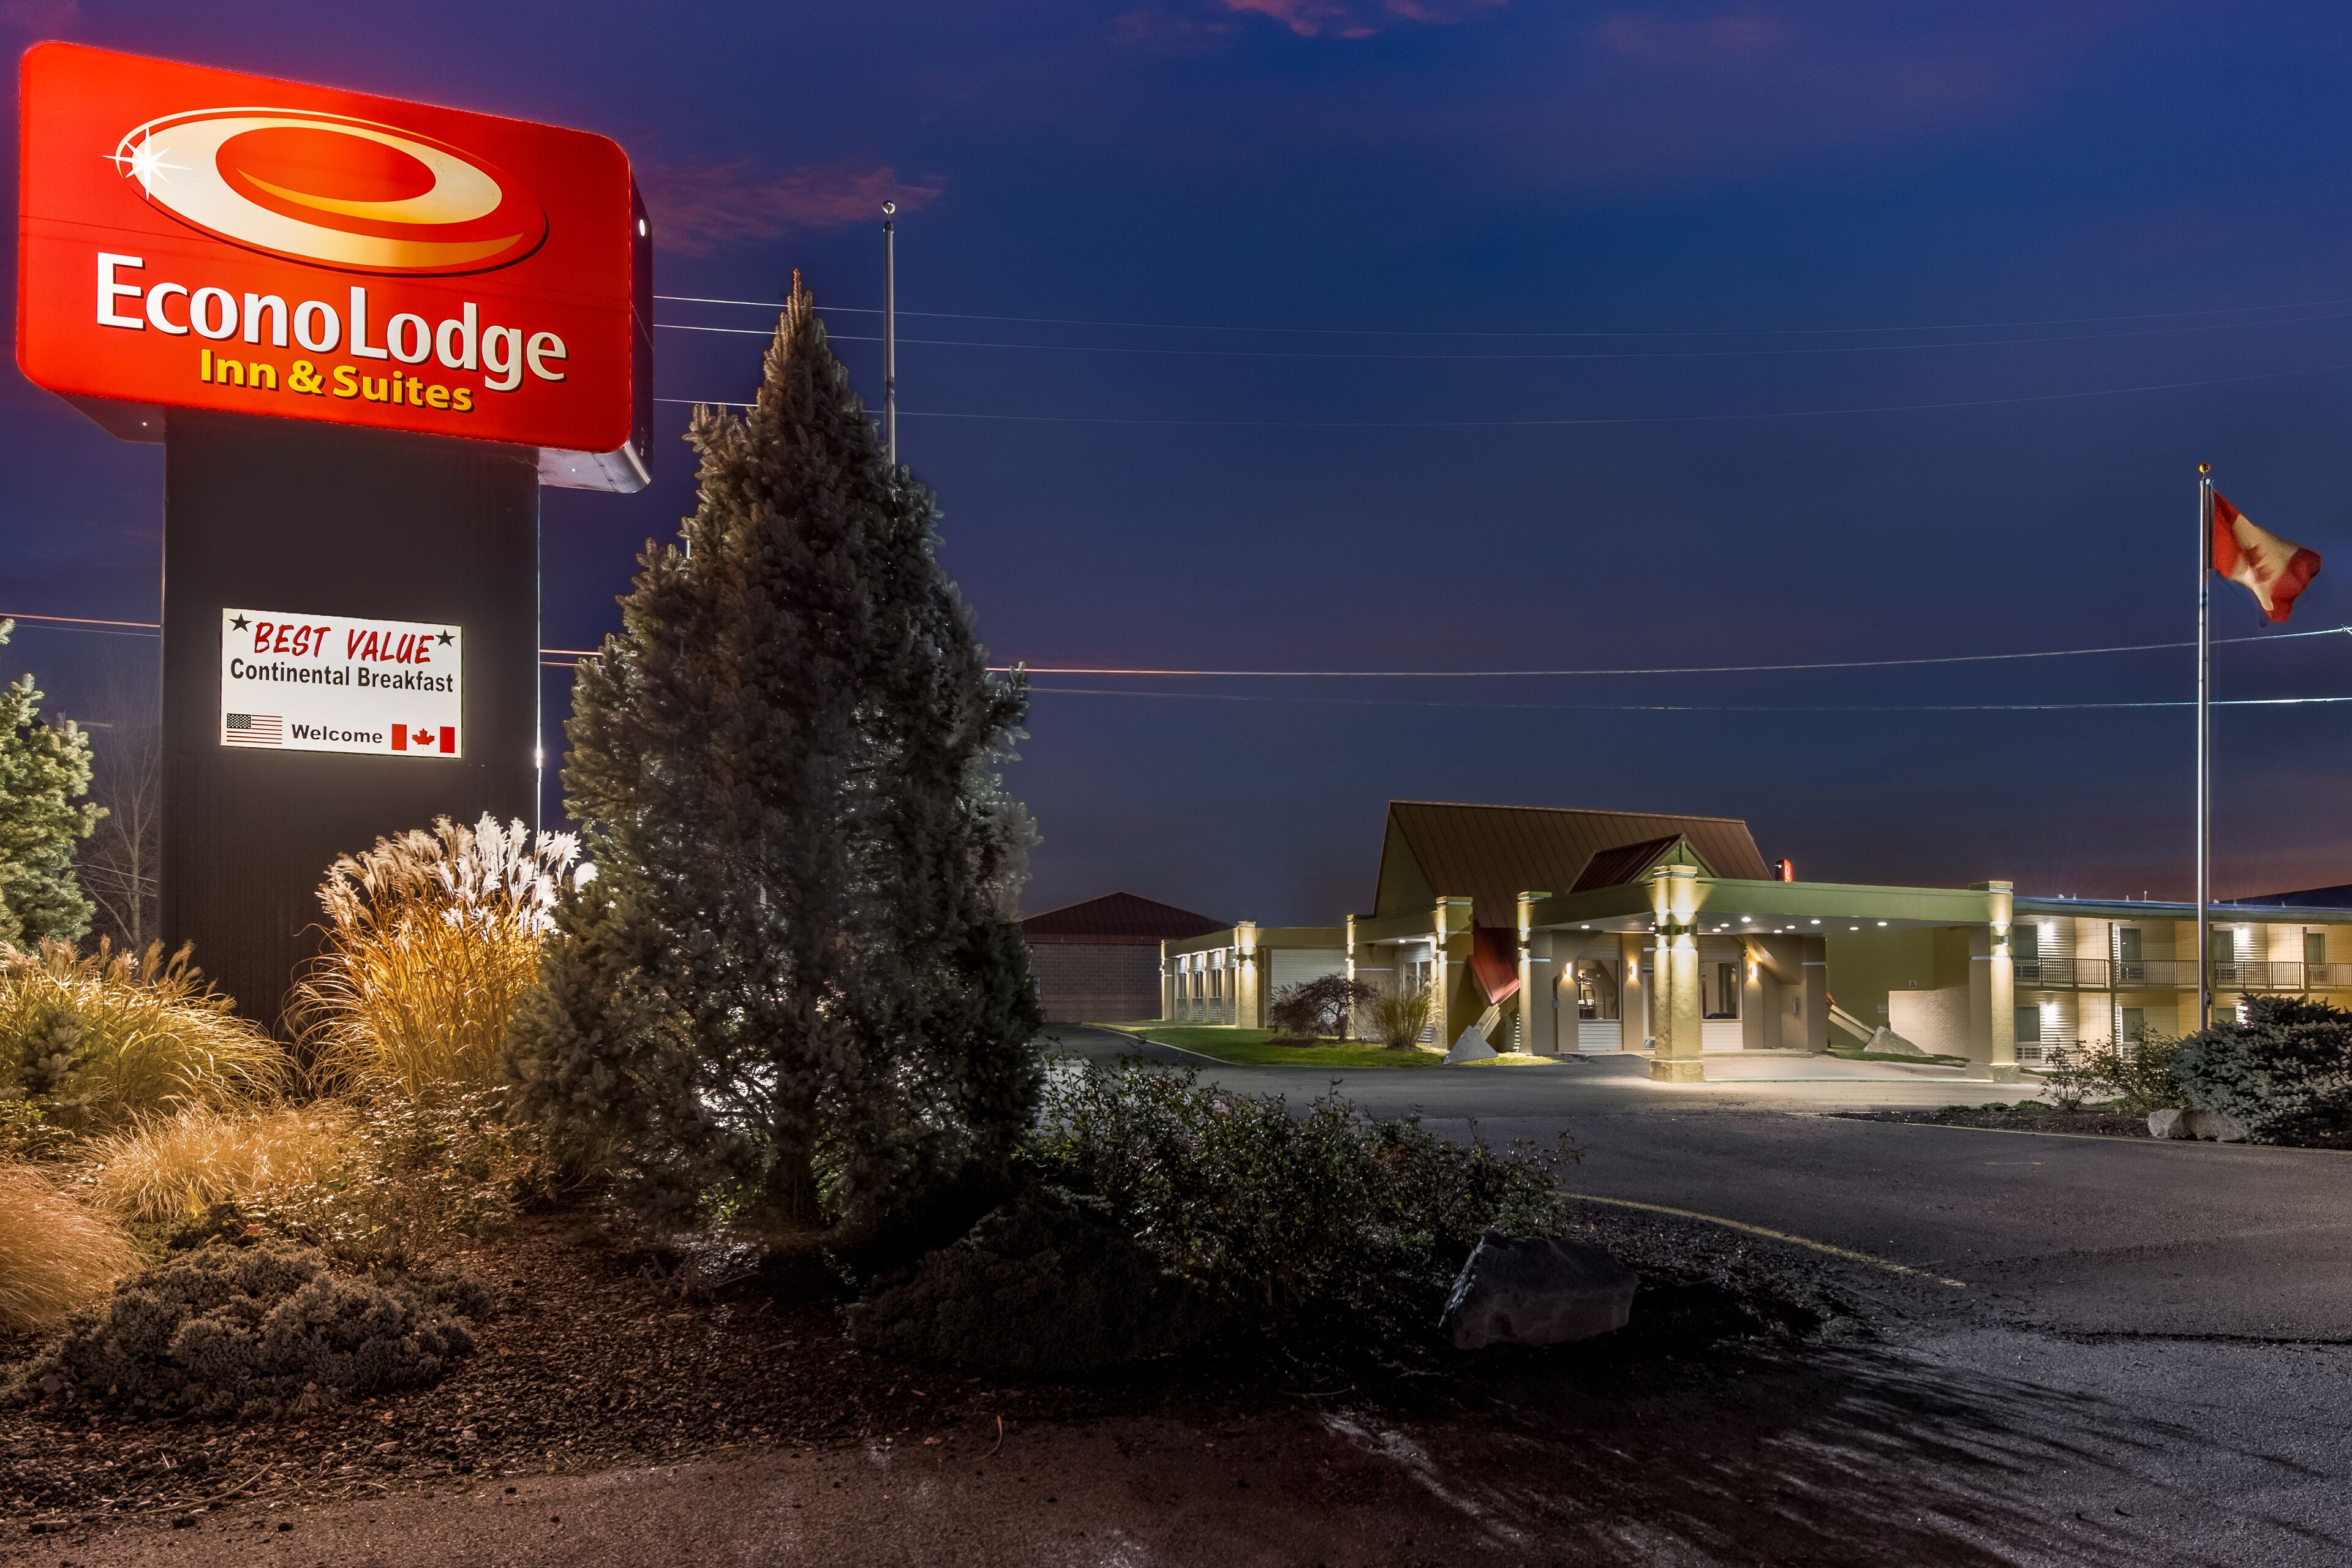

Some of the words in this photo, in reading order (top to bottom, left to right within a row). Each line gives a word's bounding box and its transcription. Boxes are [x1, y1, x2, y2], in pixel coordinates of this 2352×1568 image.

[200, 348, 277, 390] Inn
[287, 359, 324, 394] &
[332, 364, 475, 411] Suites
[254, 622, 331, 658] BEST
[347, 628, 435, 665] VALUE
[230, 658, 350, 687] Continental
[358, 666, 454, 693] Breakfast
[291, 724, 383, 744] Welcome
